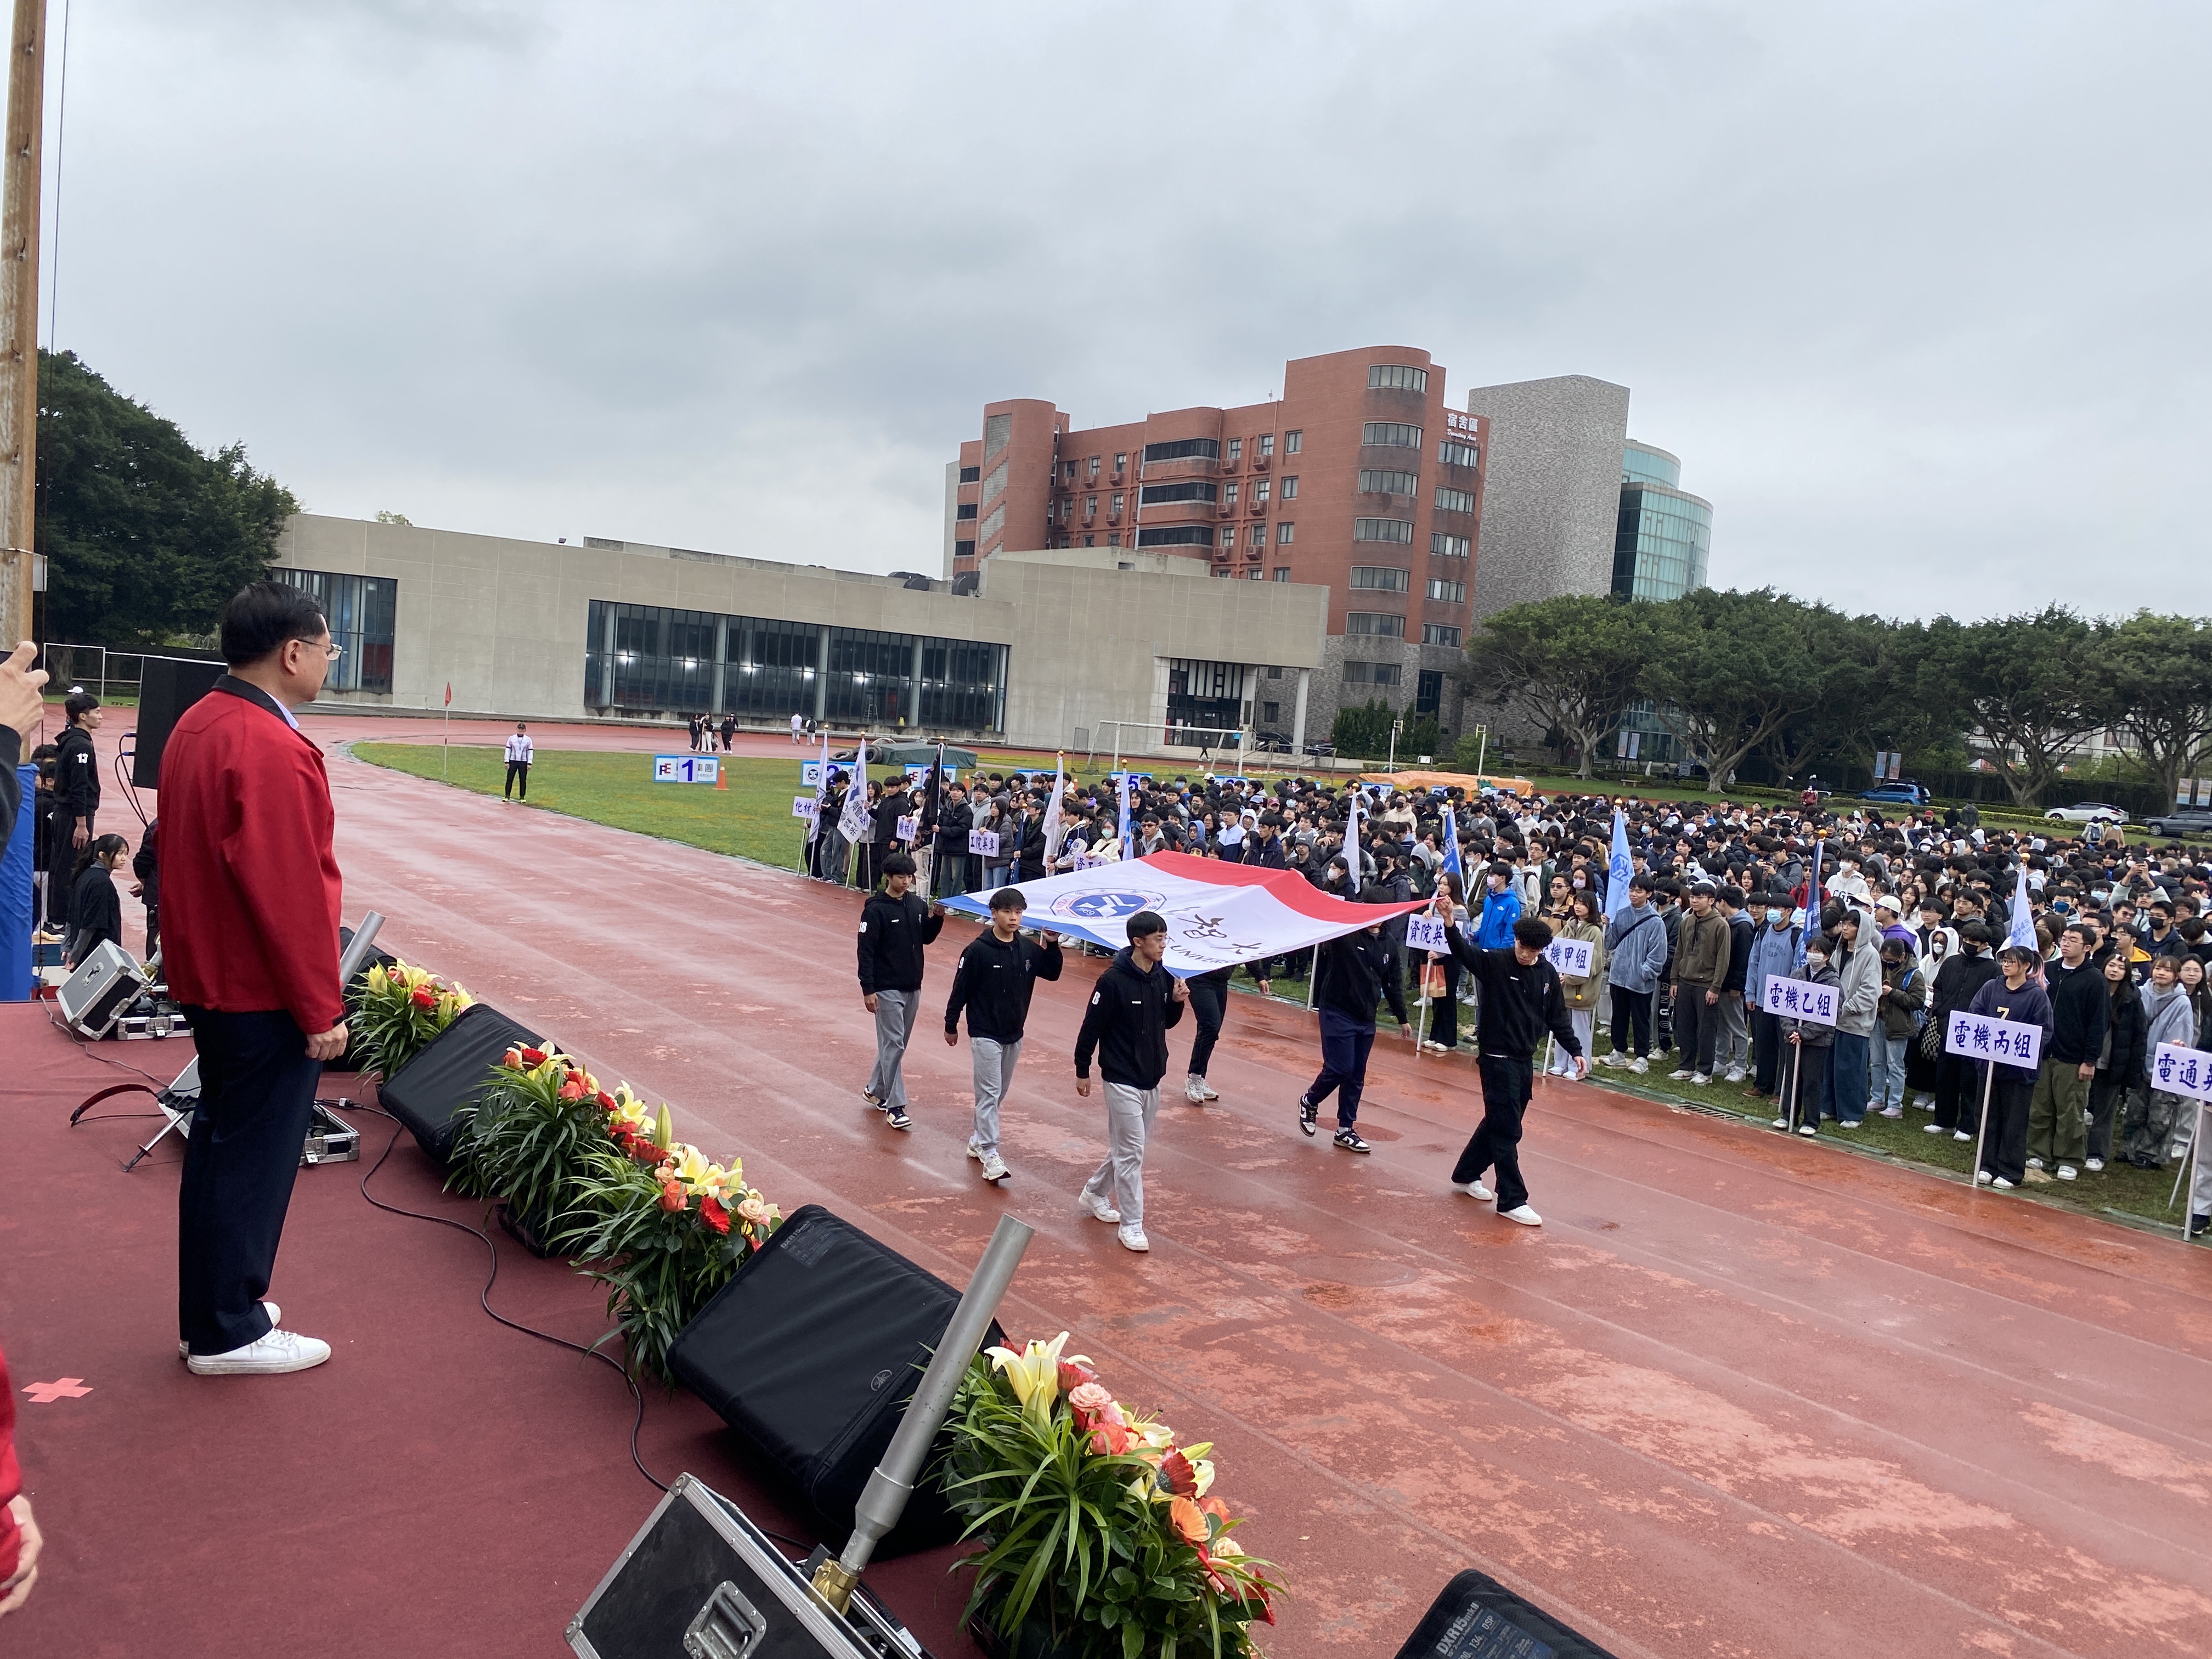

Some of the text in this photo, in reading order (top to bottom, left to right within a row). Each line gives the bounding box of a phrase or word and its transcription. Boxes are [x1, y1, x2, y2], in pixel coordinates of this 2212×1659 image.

[1448, 413, 1479, 432] 宿舍區
[76, 753, 88, 764] 13
[682, 759, 693, 781] 1
[1128, 775, 1139, 790] 5
[1410, 920, 1448, 946] 資院英
[1770, 983, 1831, 1017] 電機乙組
[1997, 1006, 2010, 1020] 7
[1954, 1020, 2032, 1059] 電機丙組
[1481, 1615, 1495, 1630] DSP
